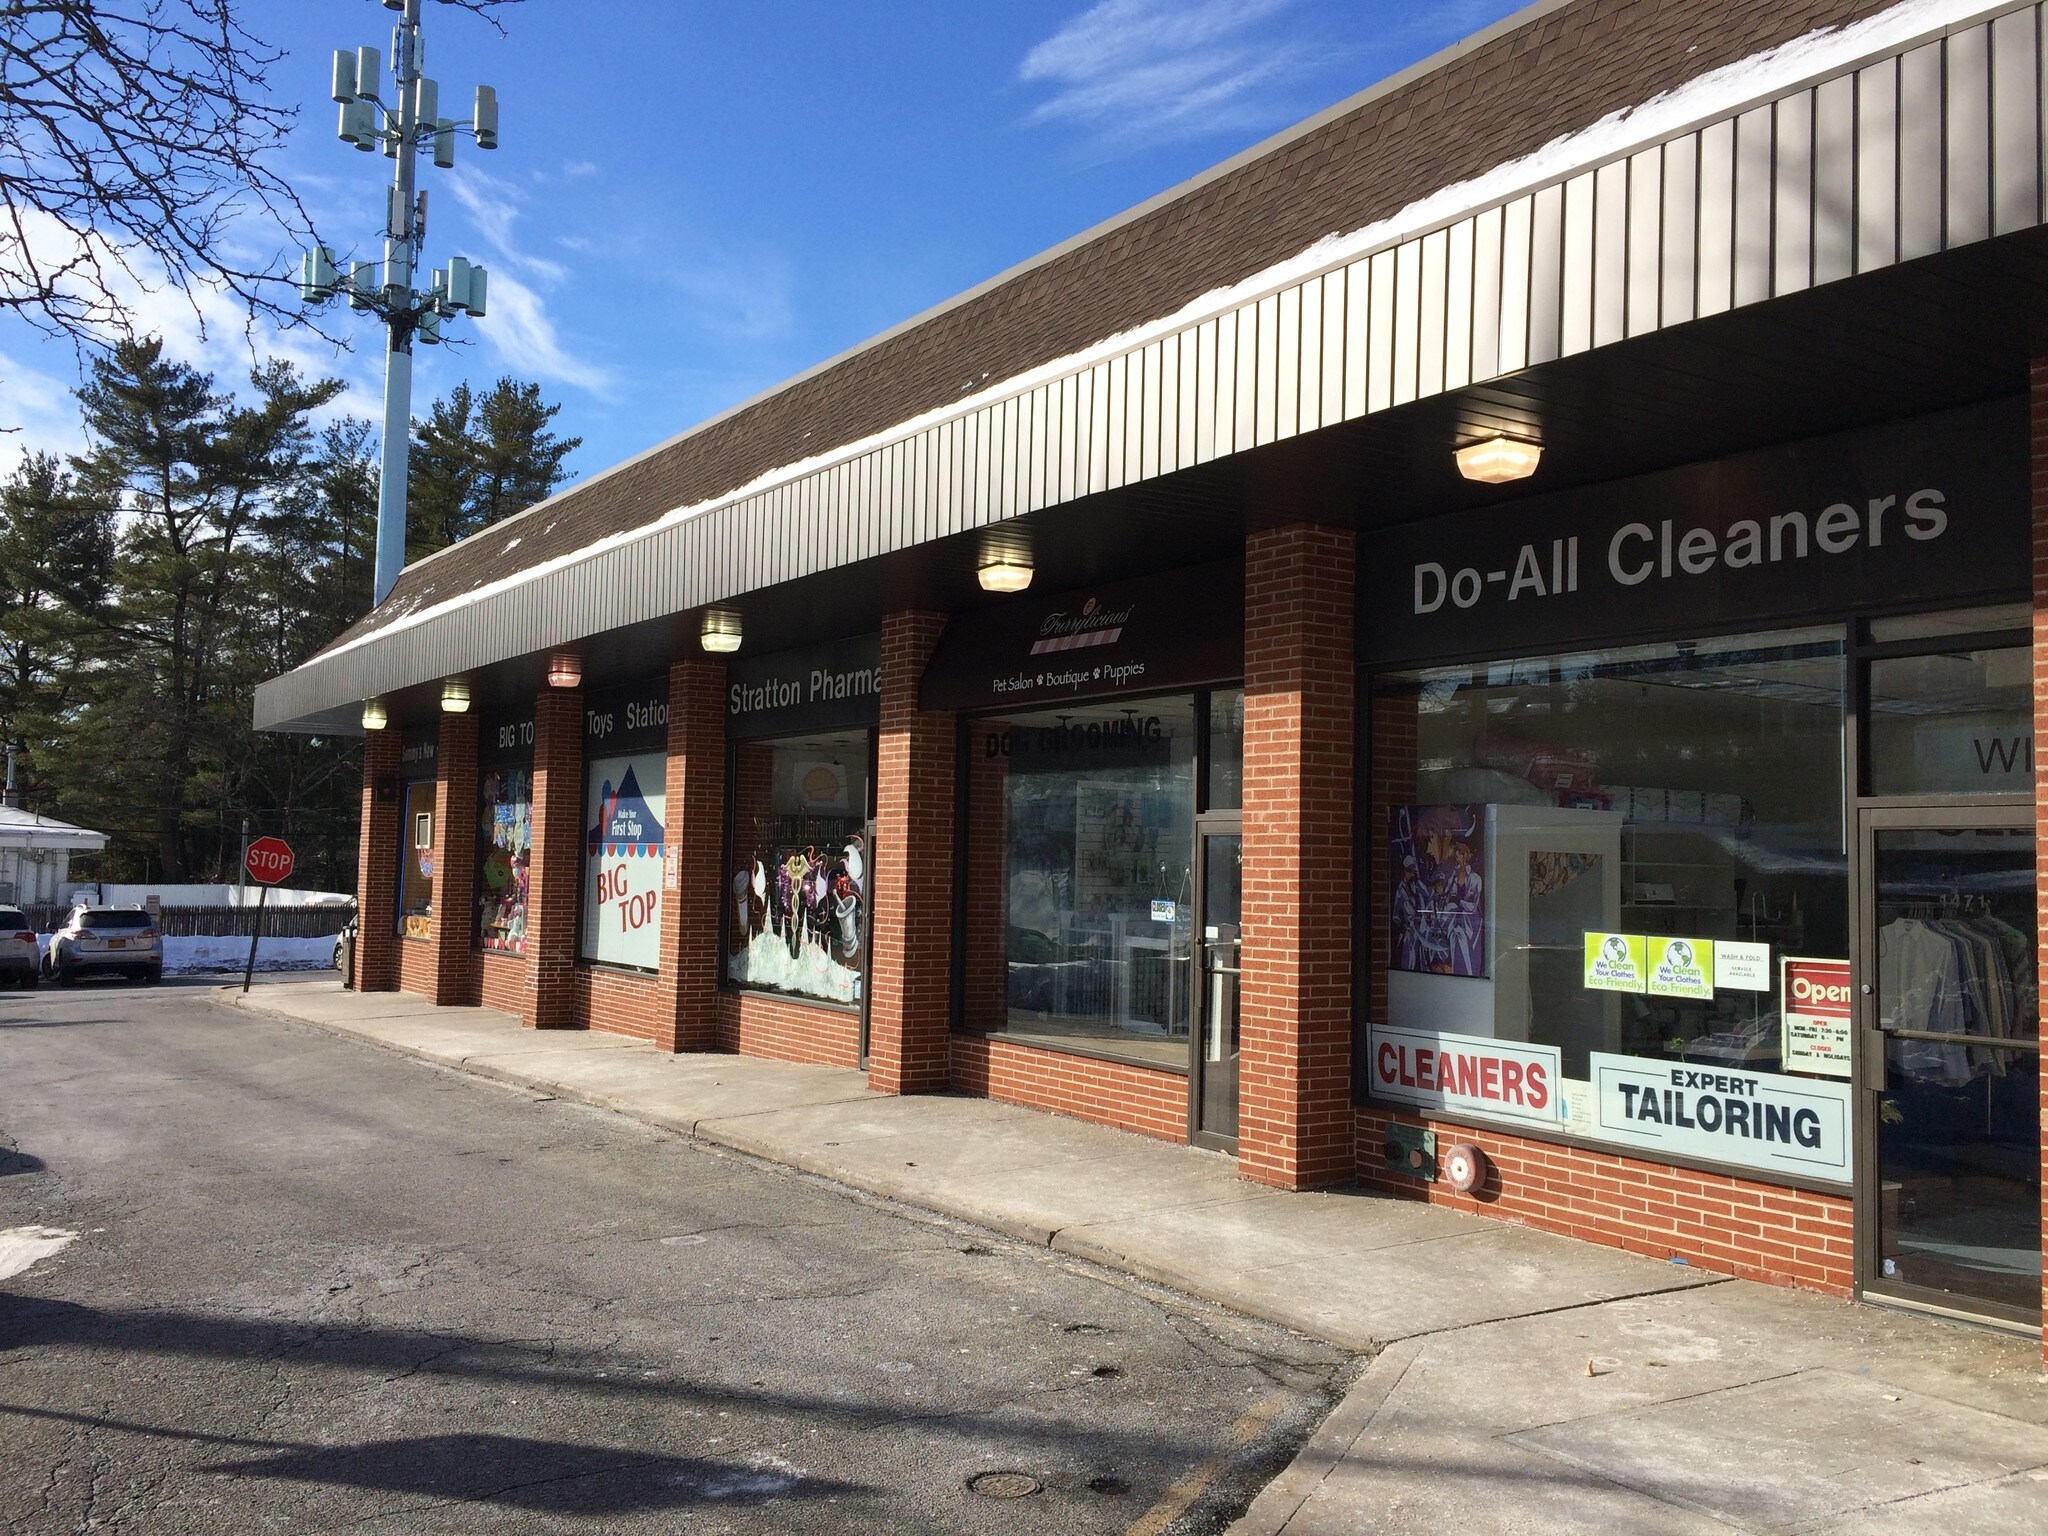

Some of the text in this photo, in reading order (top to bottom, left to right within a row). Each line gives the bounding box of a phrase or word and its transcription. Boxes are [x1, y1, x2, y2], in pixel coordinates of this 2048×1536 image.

[1413, 487, 1948, 616] Do-All Cleaners
[992, 660, 1145, 692] Pet Salon Boutique Puppies
[730, 666, 881, 715] Stratton Pharma
[499, 721, 534, 748] BIG TO
[587, 710, 613, 739] Toys
[611, 820, 642, 840] First Stop
[249, 849, 291, 871] STOP
[596, 863, 628, 905] BIG
[618, 890, 657, 933] TOP
[1596, 960, 1634, 971] We Clean
[1611, 969, 1635, 979] Clothes
[1658, 974, 1701, 984] Your Clothes
[1659, 965, 1701, 976] We Clean
[1791, 977, 1851, 1005] Open
[1810, 1044, 1832, 1052] CLOSED
[1377, 1041, 1549, 1110] CLEANERS
[1670, 1069, 1759, 1097] EXPERT
[1618, 1082, 1822, 1149] TAILORING
